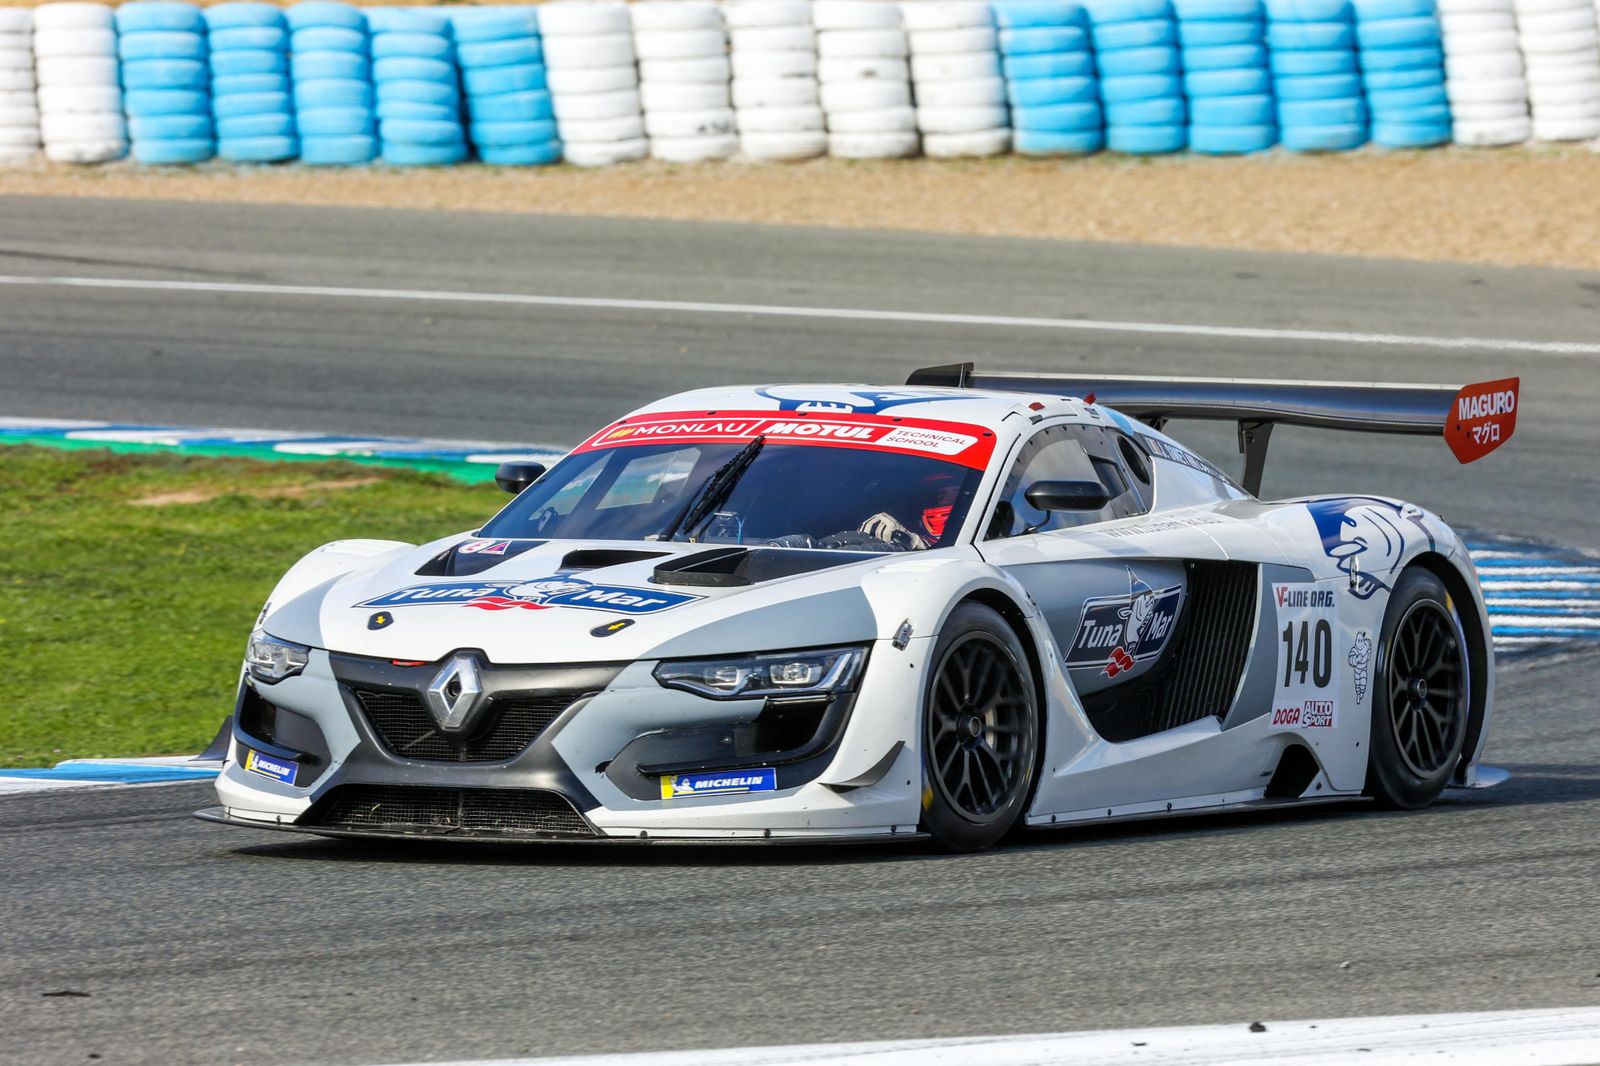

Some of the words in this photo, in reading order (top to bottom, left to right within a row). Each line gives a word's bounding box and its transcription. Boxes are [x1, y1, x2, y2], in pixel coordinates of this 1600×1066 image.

[1459, 390, 1514, 420] MAGURO
[634, 423, 746, 435] MONLAU
[761, 422, 875, 438] MOTUL
[896, 430, 967, 445] TECHNICAL
[1472, 421, 1500, 444] マグロ
[886, 436, 938, 448] SCHOOL
[392, 587, 488, 600] Tuna
[573, 588, 668, 607] Mar
[1310, 590, 1335, 608] ORG.
[1078, 620, 1123, 649] Tuna
[1146, 611, 1173, 642] Mar
[1283, 619, 1332, 688] 140
[1273, 708, 1300, 725] DOGA
[1304, 701, 1333, 716] AUTO
[1301, 714, 1332, 728] SPORT
[258, 760, 290, 776] MICHELIN
[695, 776, 763, 789] MICHELIN
